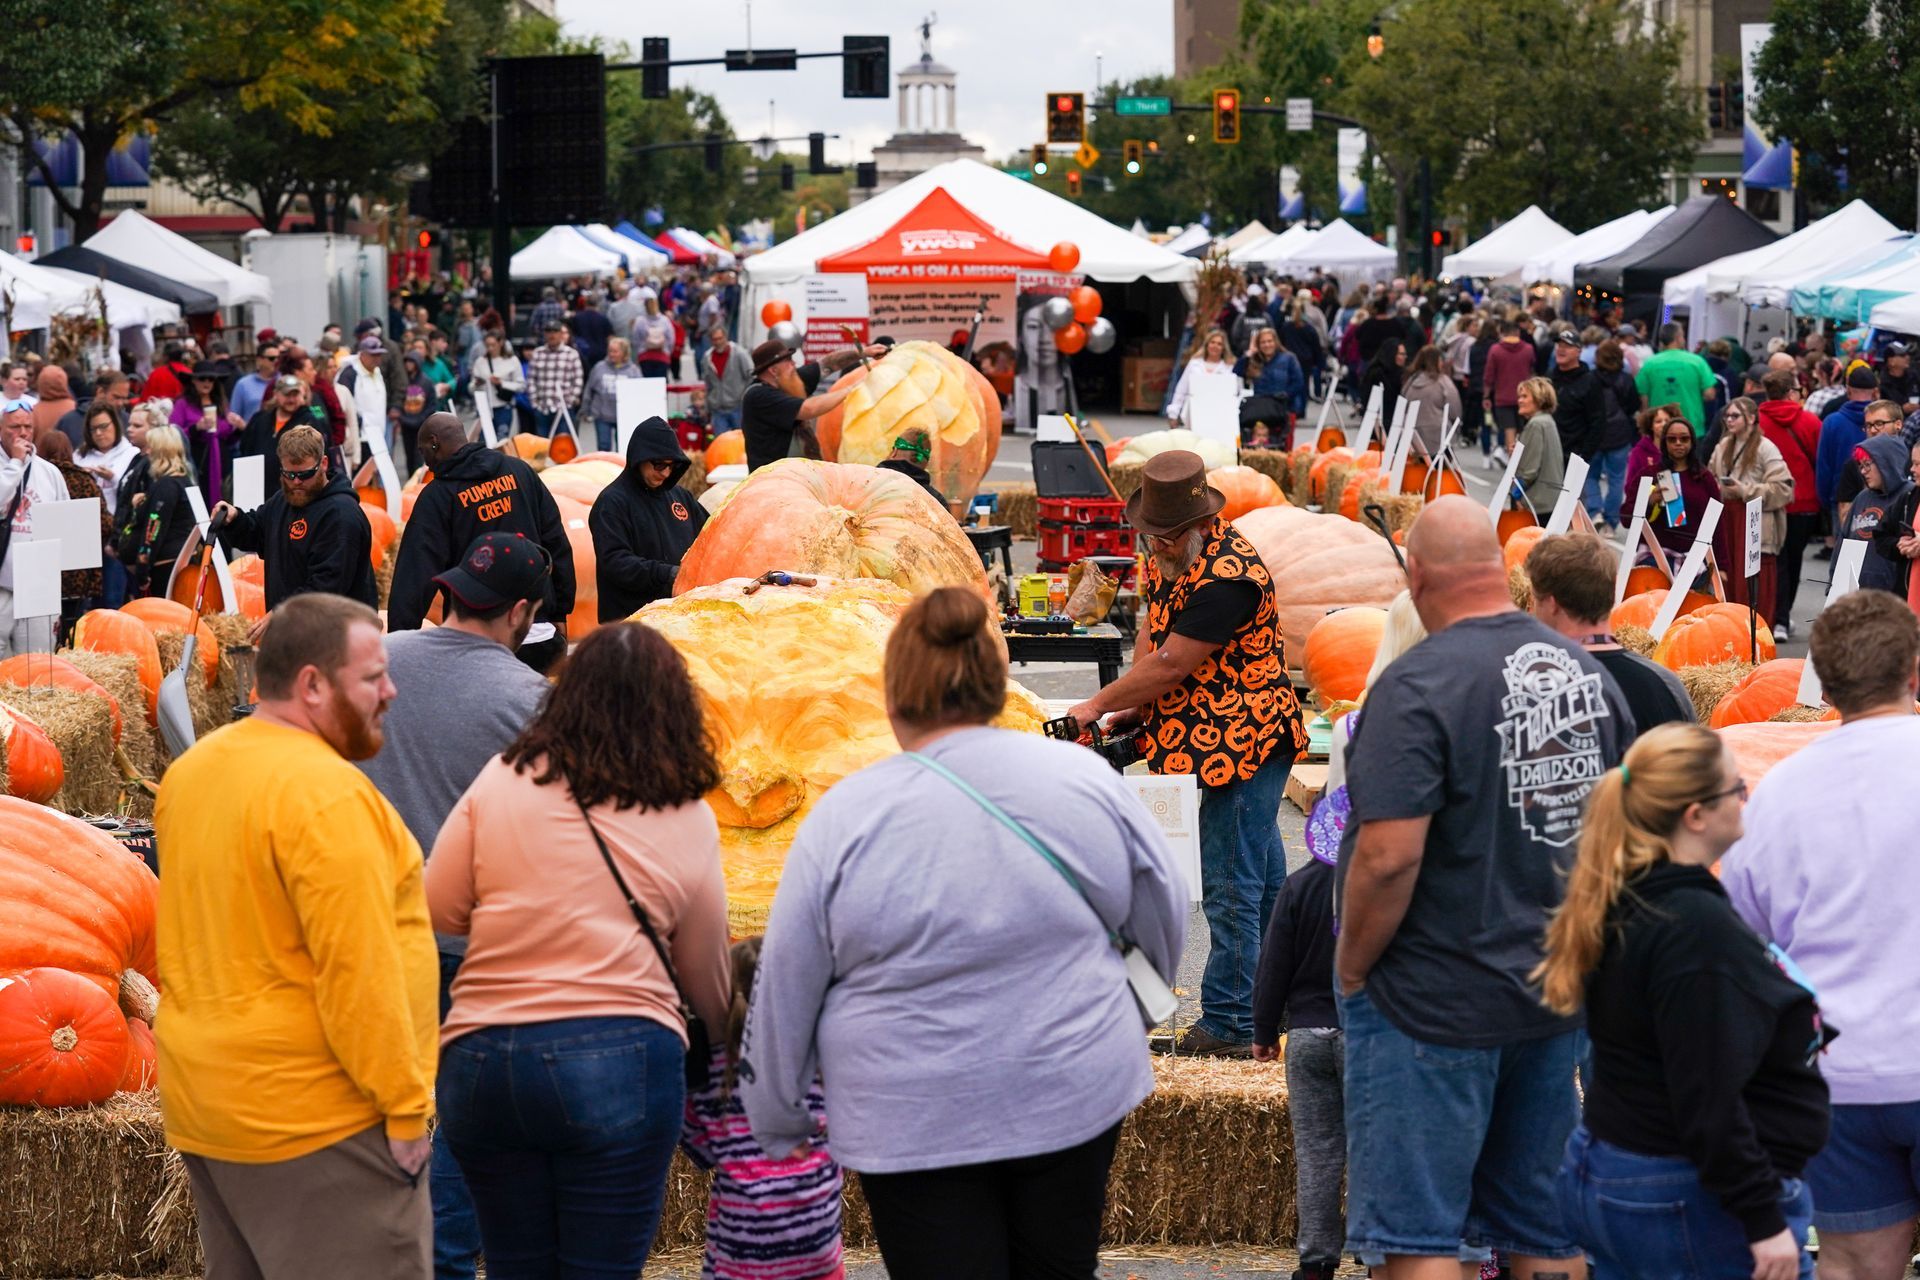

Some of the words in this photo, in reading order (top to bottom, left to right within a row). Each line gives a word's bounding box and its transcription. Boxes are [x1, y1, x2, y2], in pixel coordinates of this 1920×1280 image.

[901, 238, 976, 251] ywca
[867, 266, 909, 277] YWCA
[912, 266, 924, 276] IS
[927, 265, 948, 276] ON
[951, 265, 961, 276] A
[963, 265, 1021, 276] MISSION
[904, 292, 927, 300] until
[929, 291, 945, 299] the
[948, 291, 977, 299] world
[458, 474, 517, 507] PUMPKIN
[477, 496, 511, 521] CREW
[1513, 680, 1600, 760] HARLEY
